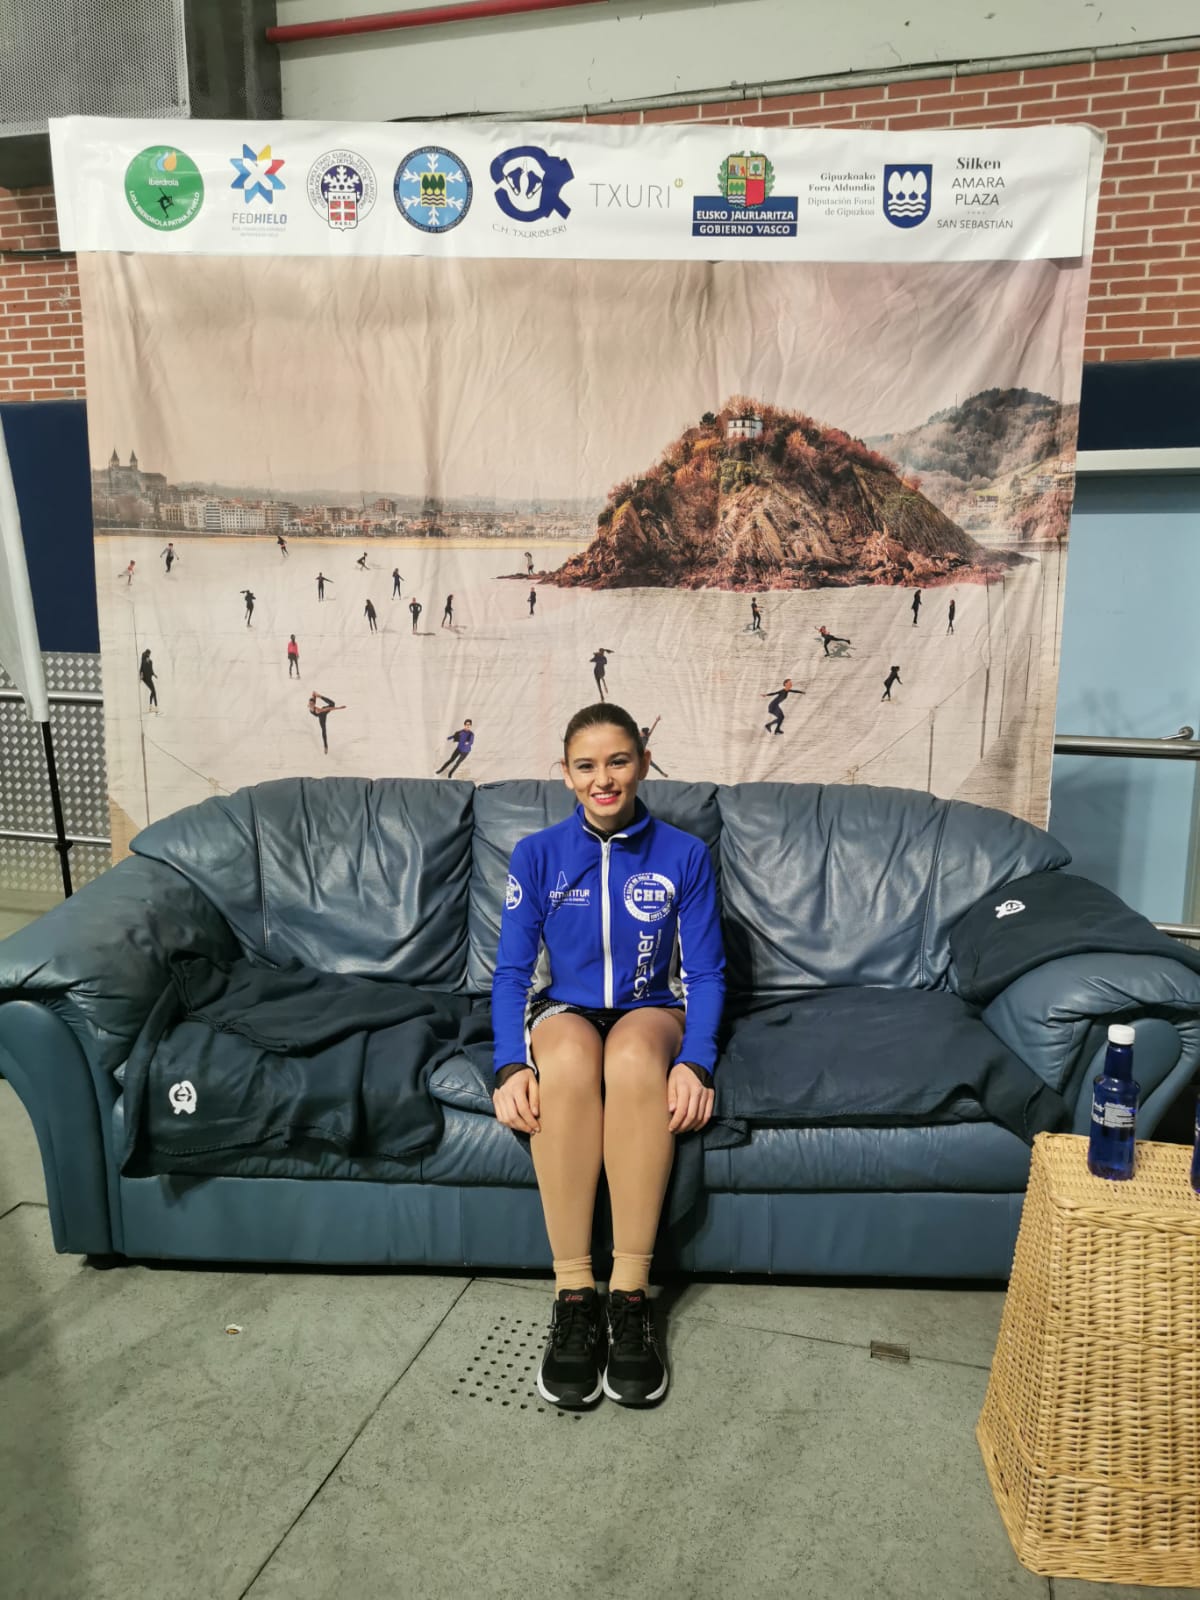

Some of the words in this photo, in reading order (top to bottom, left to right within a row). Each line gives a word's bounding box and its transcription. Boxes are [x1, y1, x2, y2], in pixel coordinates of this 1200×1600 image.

[956, 157, 1000, 170] Silken
[820, 172, 876, 182] Gipuzkoako
[952, 177, 1005, 188] AMARA
[833, 184, 875, 192] Aldundia
[130, 190, 138, 206] LIGA
[589, 184, 670, 208] TXURI
[956, 194, 1000, 206] PLAZA
[232, 213, 288, 224] FEDHIELO
[696, 210, 728, 220] EUSKO
[731, 211, 794, 222] JAURLARITZA
[700, 224, 753, 234] GOBIERNO
[756, 225, 790, 234] VASCO
[937, 220, 958, 228] SAN
